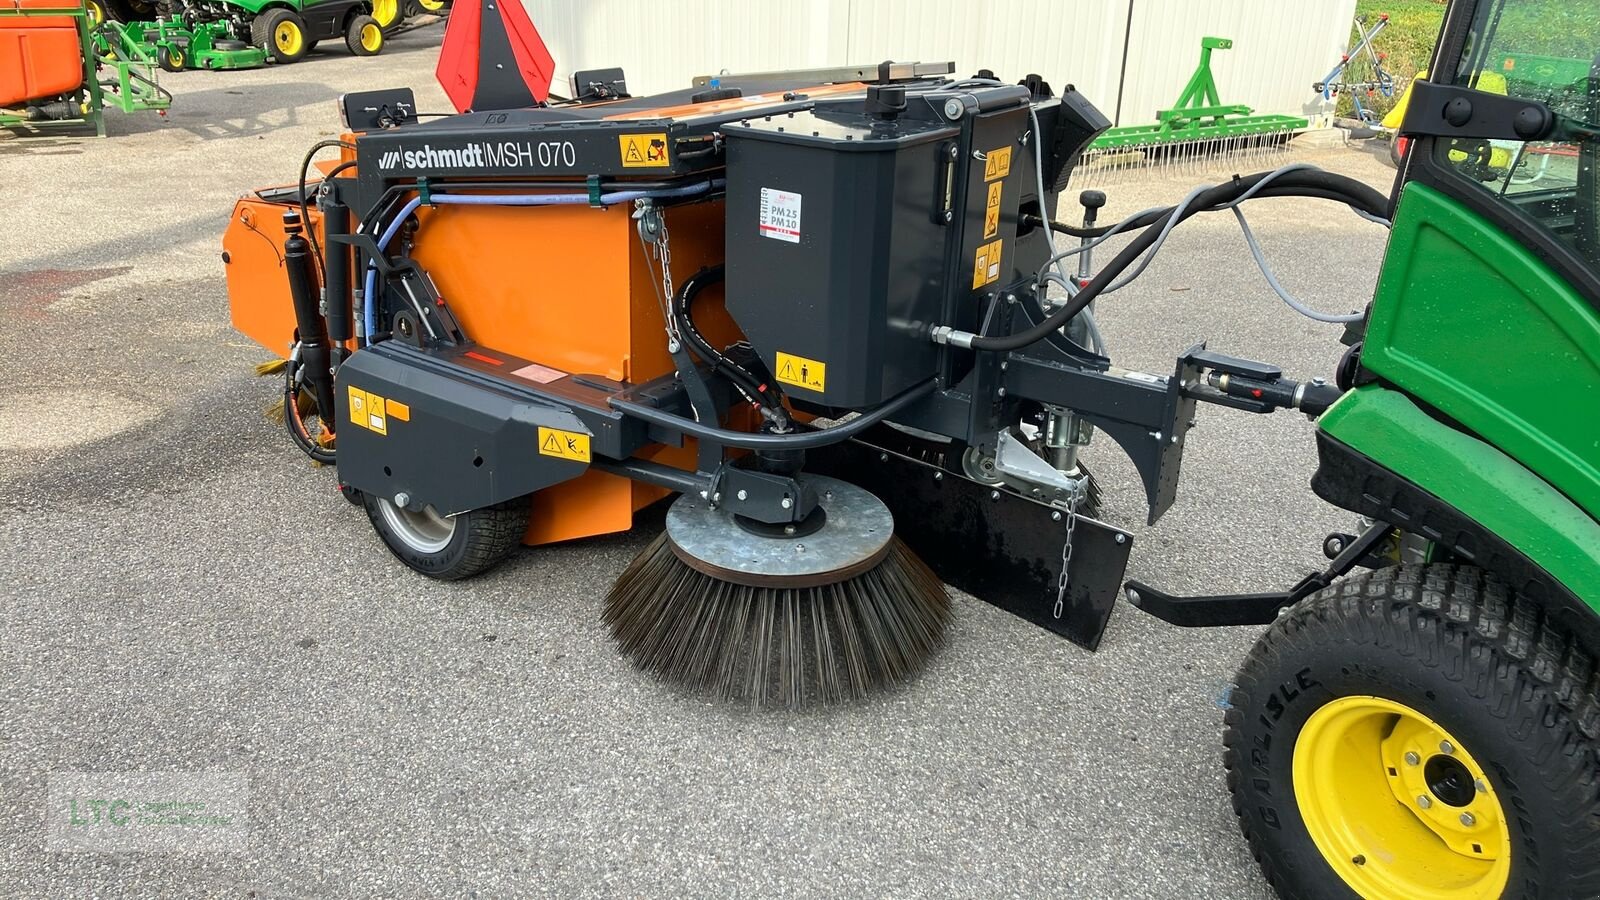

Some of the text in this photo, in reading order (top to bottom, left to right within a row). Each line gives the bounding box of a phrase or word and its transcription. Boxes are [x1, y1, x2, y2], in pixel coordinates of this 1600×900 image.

[405, 141, 576, 169] schmidt MSH 070
[771, 206, 785, 217] PM
[771, 216, 797, 229] PM 10
[1251, 667, 1322, 831] CARLISLE
